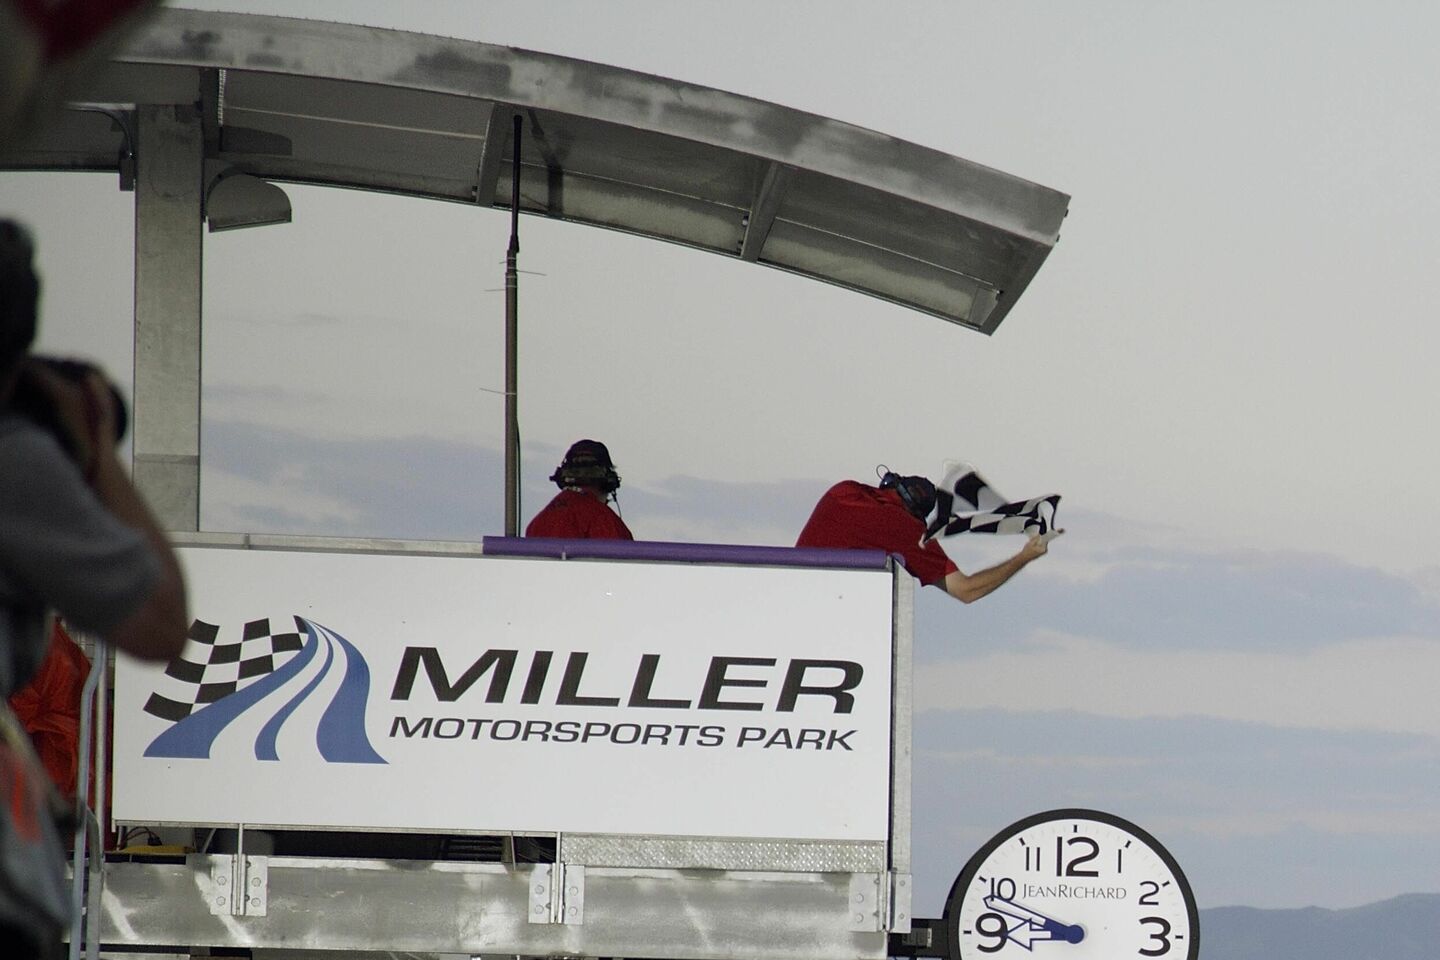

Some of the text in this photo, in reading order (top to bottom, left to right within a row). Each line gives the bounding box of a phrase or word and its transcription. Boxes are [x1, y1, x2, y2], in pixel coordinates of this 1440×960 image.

[391, 646, 864, 714] MILLER
[389, 716, 859, 752] MOTORSPORTS PARK
[1025, 846, 1040, 872] 11
[1056, 836, 1100, 878] 12
[1118, 848, 1122, 874] 1
[990, 877, 1016, 902] 10
[1138, 880, 1160, 906] 2
[975, 912, 1008, 953] 9
[1138, 916, 1172, 957] 3
